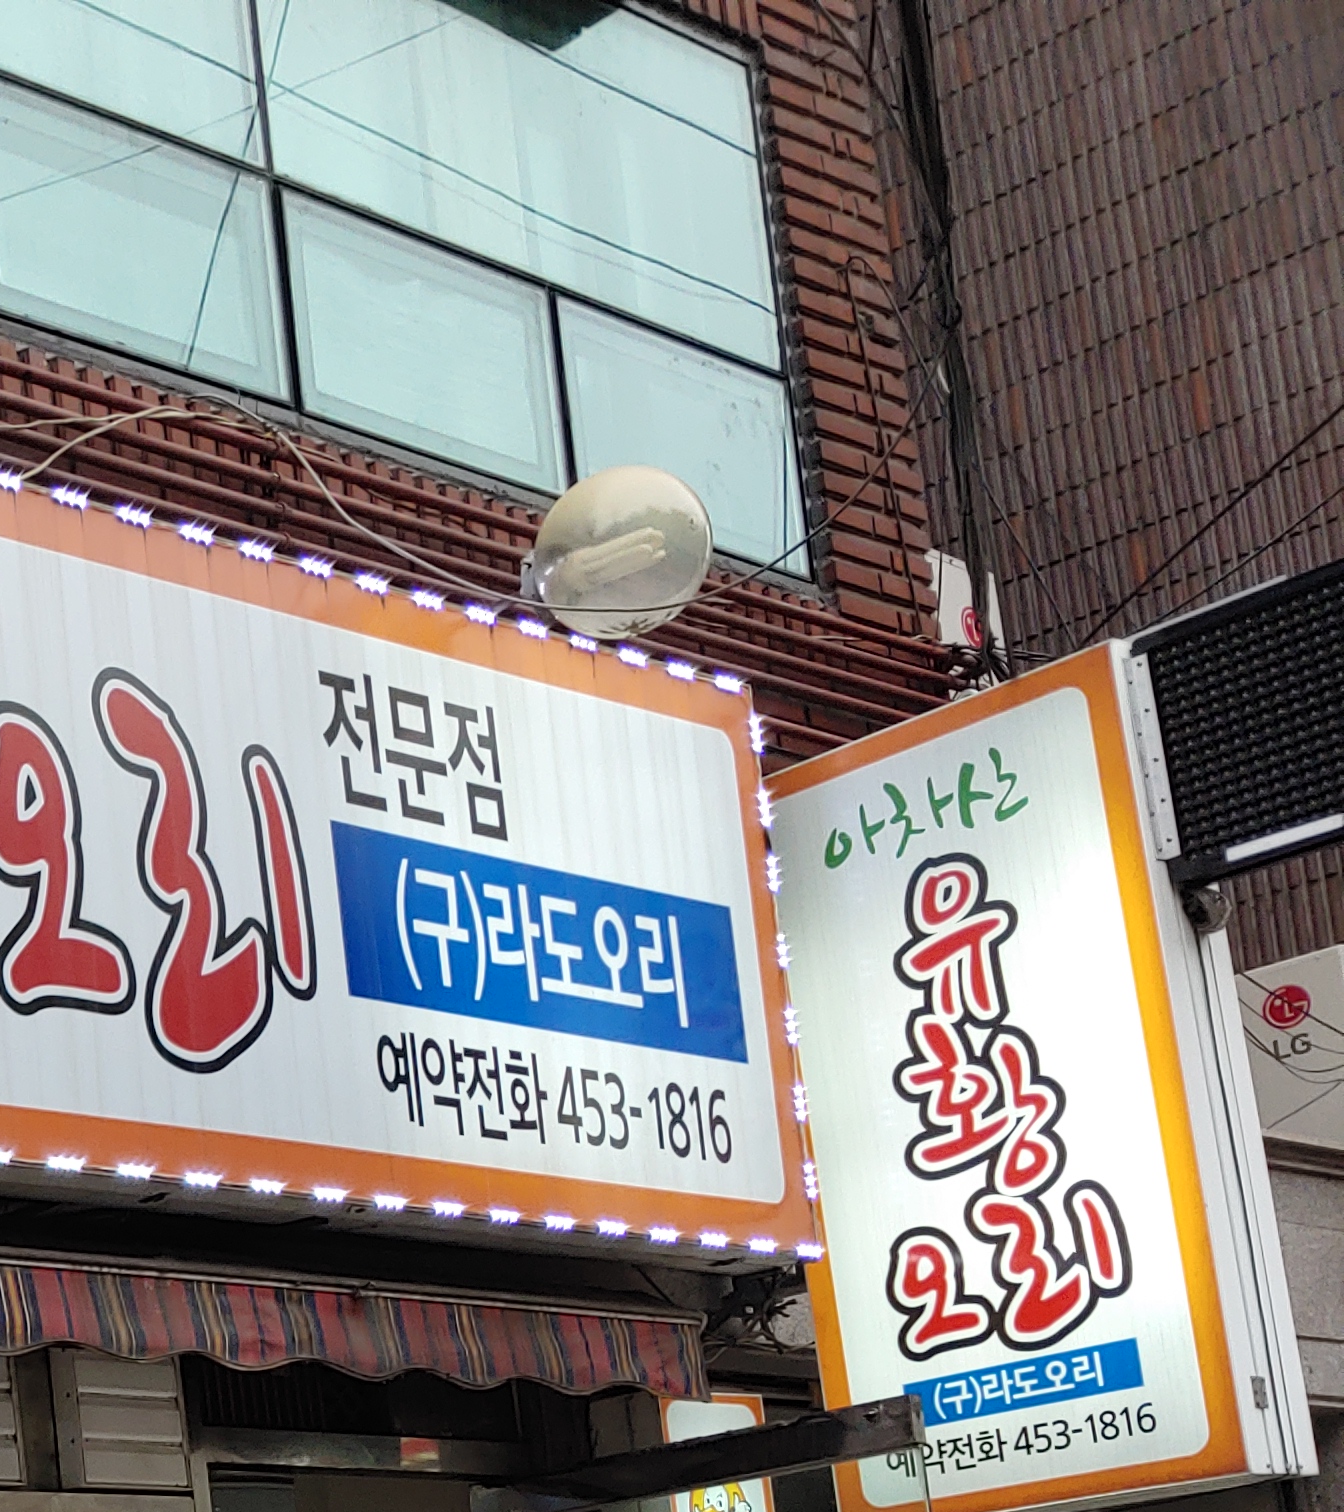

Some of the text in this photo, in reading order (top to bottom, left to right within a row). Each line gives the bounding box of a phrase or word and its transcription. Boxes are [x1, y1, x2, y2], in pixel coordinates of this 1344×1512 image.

[318, 669, 509, 842] 전문점
[823, 747, 1030, 870] 아차산
[395, 858, 690, 1029] (구)라도오리
[377, 1032, 733, 1165] 예약전화 453-1816
[1272, 1033, 1312, 1061] LG
[886, 1402, 1157, 1478] 예약전화 453-1816
[934, 1350, 1105, 1420] (구)라도오리
